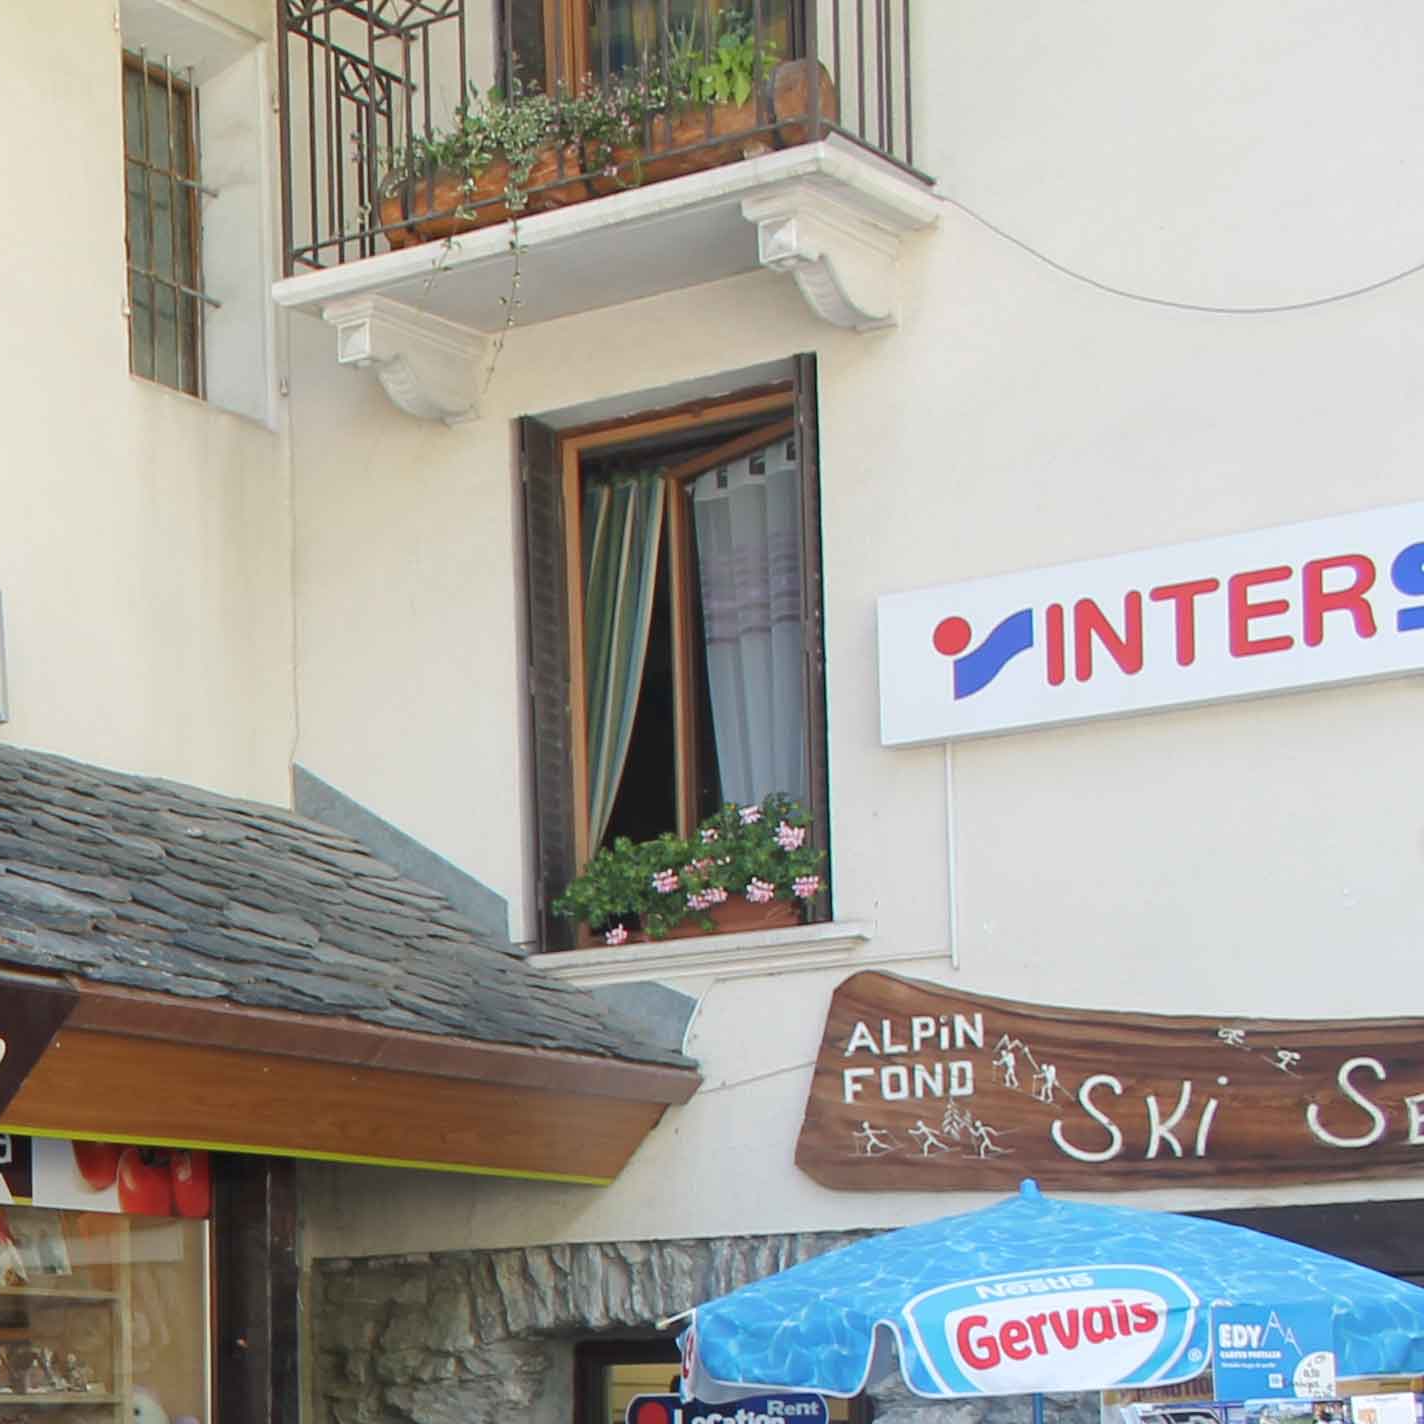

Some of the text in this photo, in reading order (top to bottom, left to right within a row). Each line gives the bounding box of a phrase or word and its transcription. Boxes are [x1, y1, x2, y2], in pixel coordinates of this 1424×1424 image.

[843, 1060, 976, 1103] FOND
[956, 1299, 1159, 1370] Gervais
[1218, 1323, 1262, 1349] EDY
[767, 1399, 820, 1416] Rent
